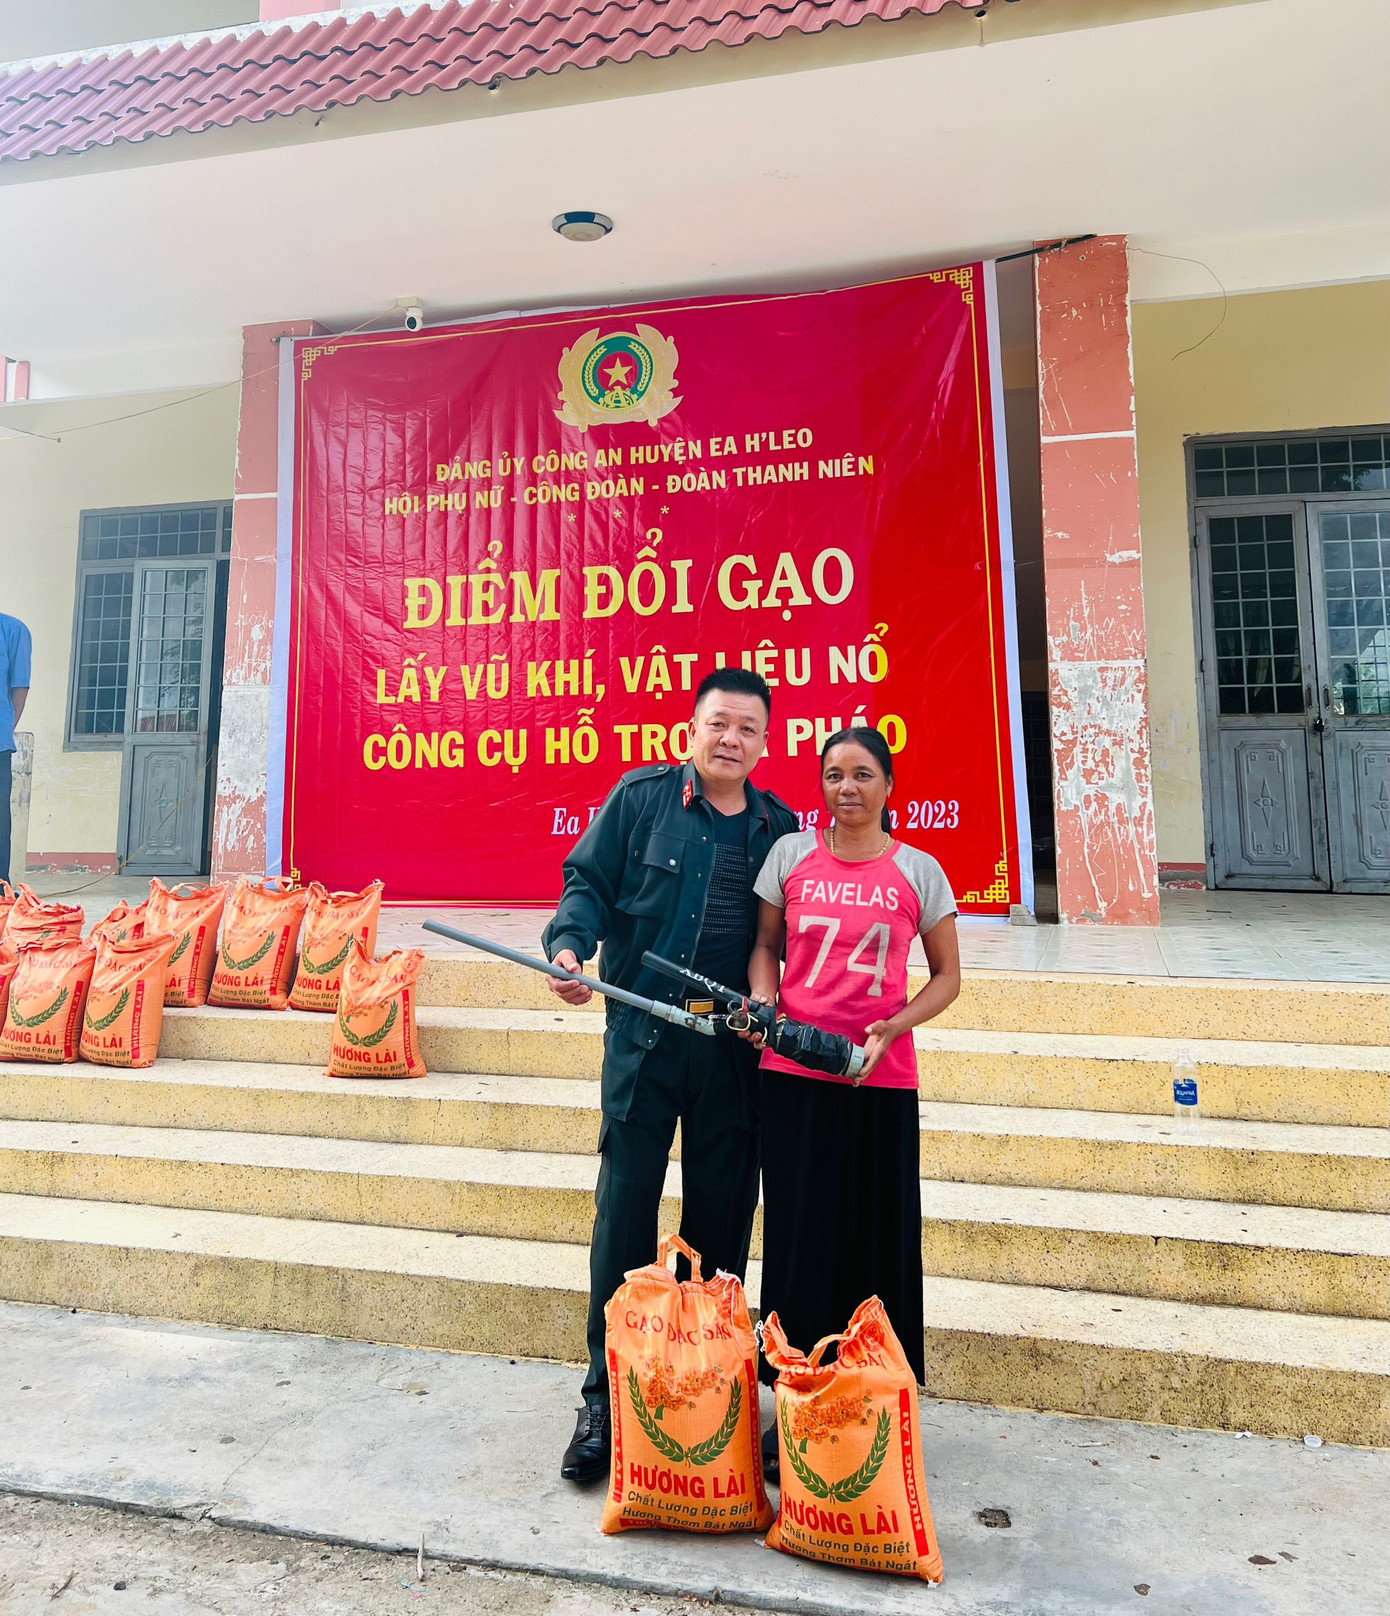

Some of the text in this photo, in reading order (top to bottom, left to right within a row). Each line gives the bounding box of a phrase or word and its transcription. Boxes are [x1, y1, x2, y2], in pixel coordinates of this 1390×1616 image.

[436, 455, 492, 481] ĐẢNG
[498, 451, 526, 476] ỦY
[532, 449, 588, 474] CÔNG
[594, 447, 622, 468] AN
[630, 437, 702, 465] HUYỆN
[709, 435, 738, 457] EA
[384, 491, 419, 518] HỘI
[426, 492, 467, 514] PHỤ
[475, 485, 505, 509] NỮ
[524, 481, 580, 505] CÔNG
[586, 478, 644, 501] ĐOÀN
[666, 467, 726, 494] ĐOÀN
[732, 461, 809, 487] THANH
[818, 452, 874, 479] NIÊN
[403, 527, 854, 628] ĐIỂM ĐỔI GẠO
[376, 652, 448, 704] LẤY
[460, 653, 510, 700] VŨ
[527, 648, 605, 702] KHÍ,
[619, 644, 699, 700] VẬT
[828, 622, 889, 684] NỔ
[363, 723, 464, 770] CÔNG
[477, 728, 527, 773] CỤ
[545, 707, 599, 765] HỖ
[551, 807, 580, 835] Ea
[906, 799, 960, 829] 2023
[800, 879, 899, 911] FAVELAS
[798, 915, 891, 997] 74
[244, 973, 264, 987] LÀI
[36, 1030, 57, 1046] LÀI
[103, 1034, 122, 1049] LÀI
[333, 1043, 397, 1064] HƯƠNG LÀI
[630, 1462, 746, 1499] HƯƠNG LÀI
[622, 1506, 662, 1521] Hương
[665, 1515, 700, 1528] Thơm
[627, 1490, 754, 1519] Chất Lượng Đặc Biệt
[784, 1491, 899, 1536] HƯƠNG LÀI
[784, 1519, 911, 1558] Chất Lượng Đặc Biệt
[820, 1550, 856, 1565] Thơm
